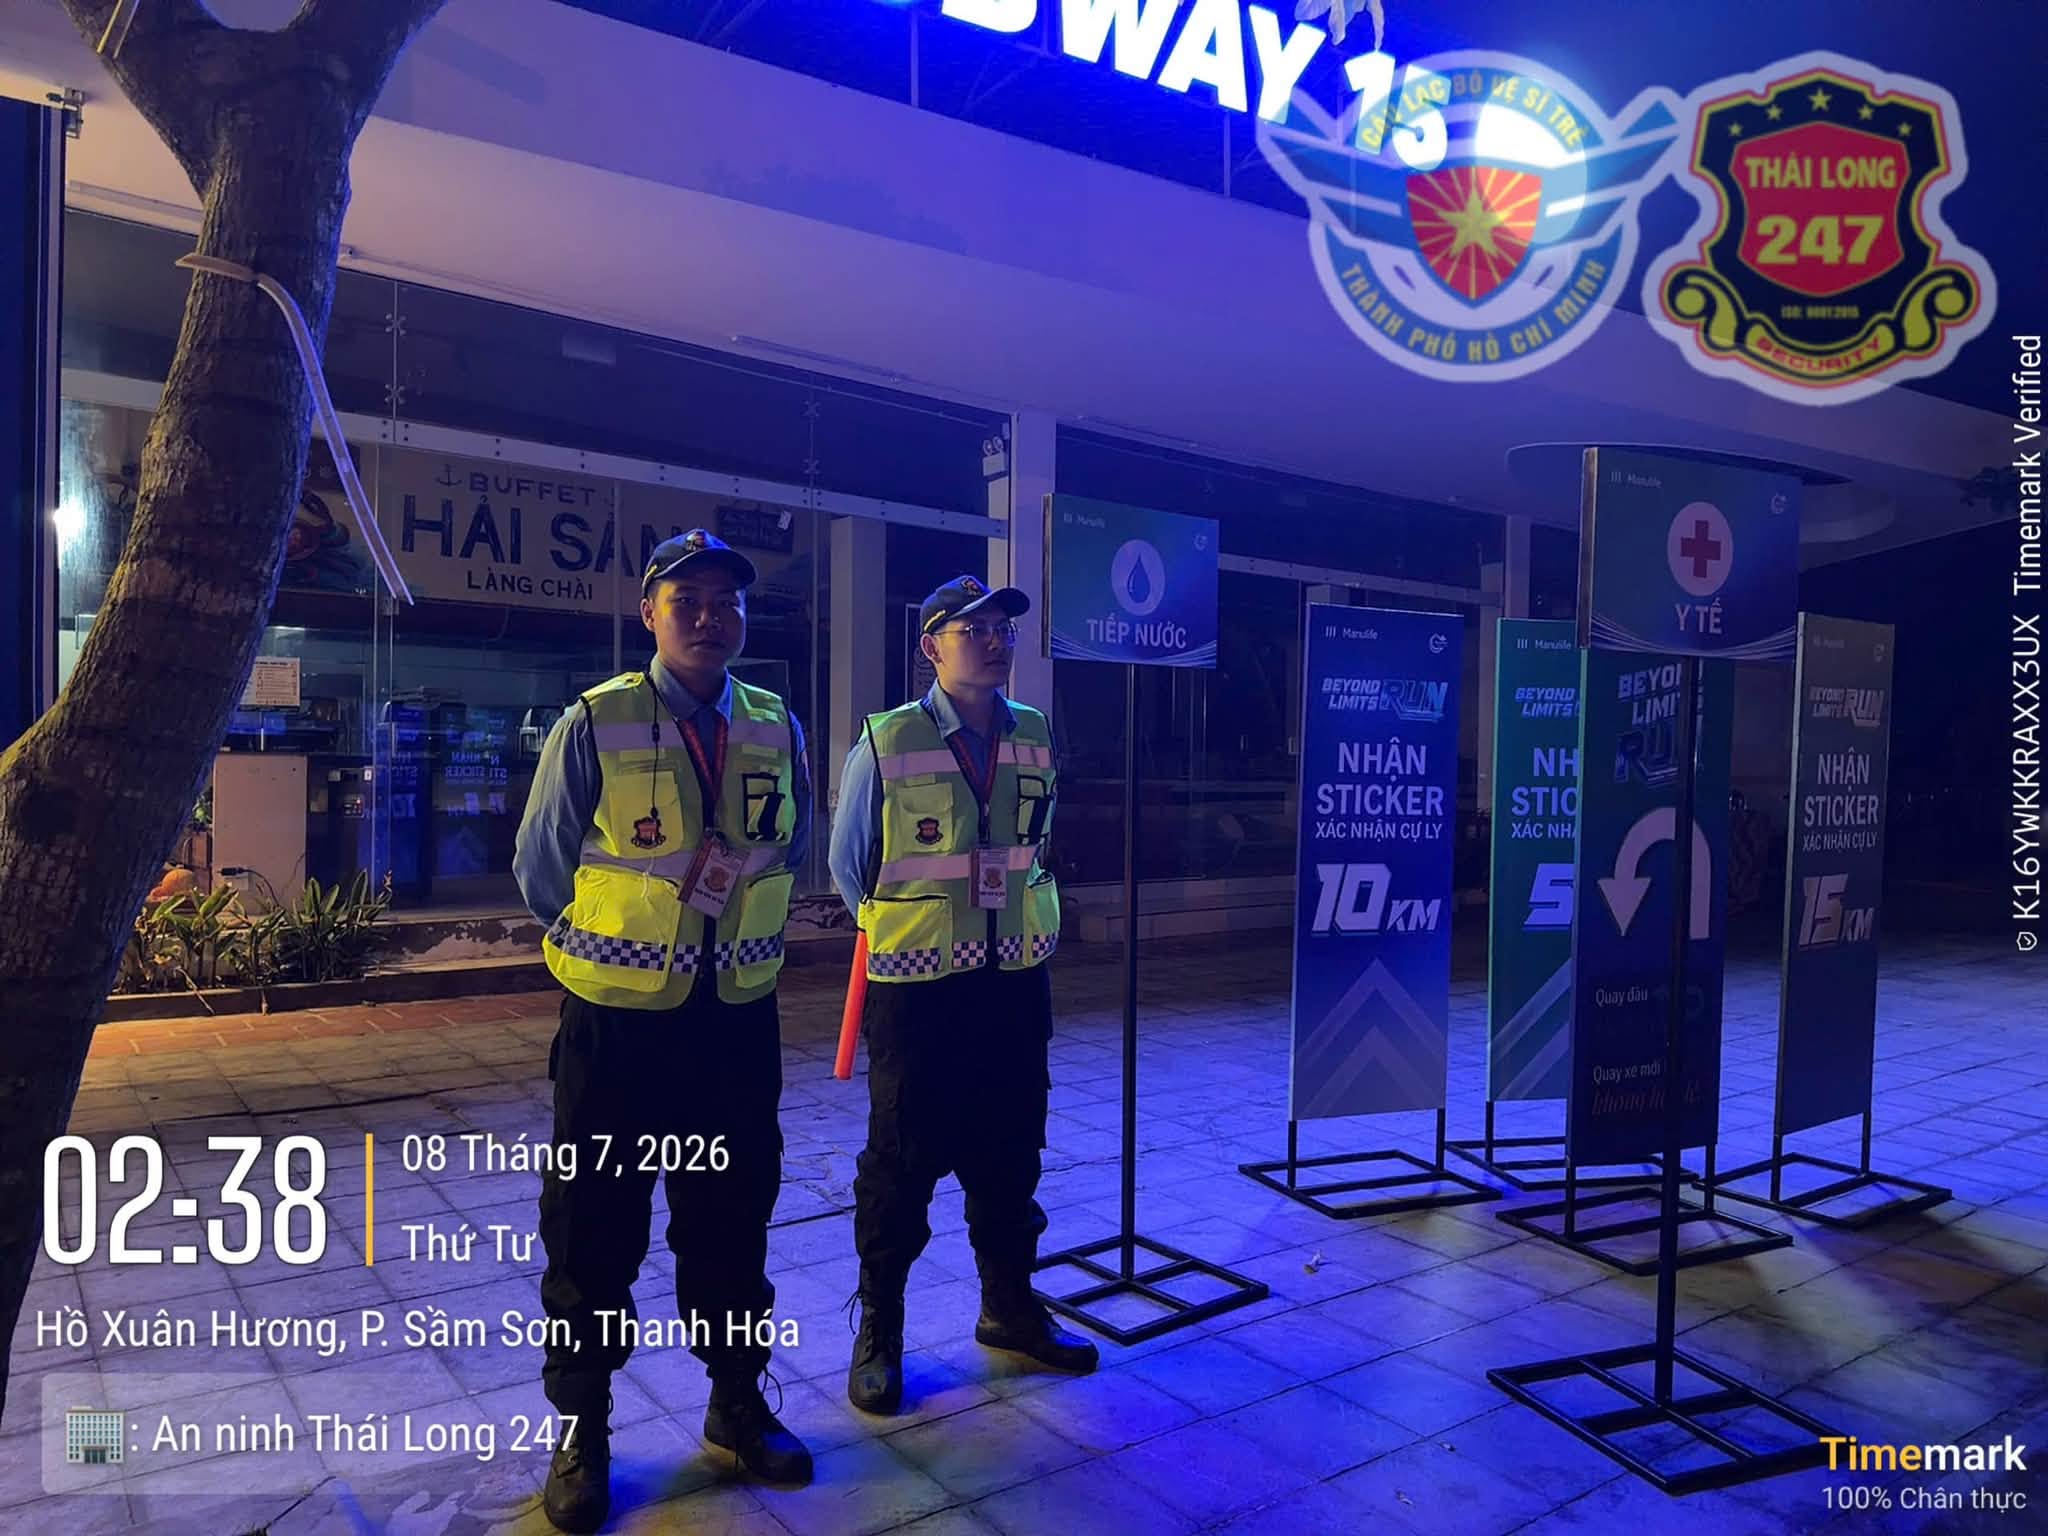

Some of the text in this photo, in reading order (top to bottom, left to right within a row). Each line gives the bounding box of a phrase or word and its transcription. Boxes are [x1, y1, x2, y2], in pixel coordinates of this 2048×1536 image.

[1344, 50, 1448, 170] 15
[469, 472, 596, 507] BUFFET
[401, 494, 522, 565] HẢI
[467, 567, 592, 601] LÀNG CHÀI
[1086, 612, 1188, 649] TIẾP NƯỚC
[1674, 597, 1723, 635] Y TẾ
[1515, 687, 1575, 701] BEYOND
[1618, 663, 1683, 699] BEYO
[1322, 677, 1449, 723] BEYOND RUN
[1327, 694, 1379, 711] LIMITS
[1522, 702, 1574, 718] LIMITS
[1631, 692, 1683, 725] LIMI
[1338, 736, 1427, 782] NHẬN
[1533, 747, 1579, 777] NH
[1817, 746, 1870, 791] NHẬN
[1316, 783, 1444, 816] STICKER
[1511, 785, 1577, 818] STIC
[1804, 795, 1879, 828] STICKER
[1315, 818, 1443, 842] XÁC NHẬN CỰ LY
[1511, 818, 1543, 839] XÁC
[1595, 984, 1626, 1008] Quay
[1592, 1063, 1623, 1087] Quay
